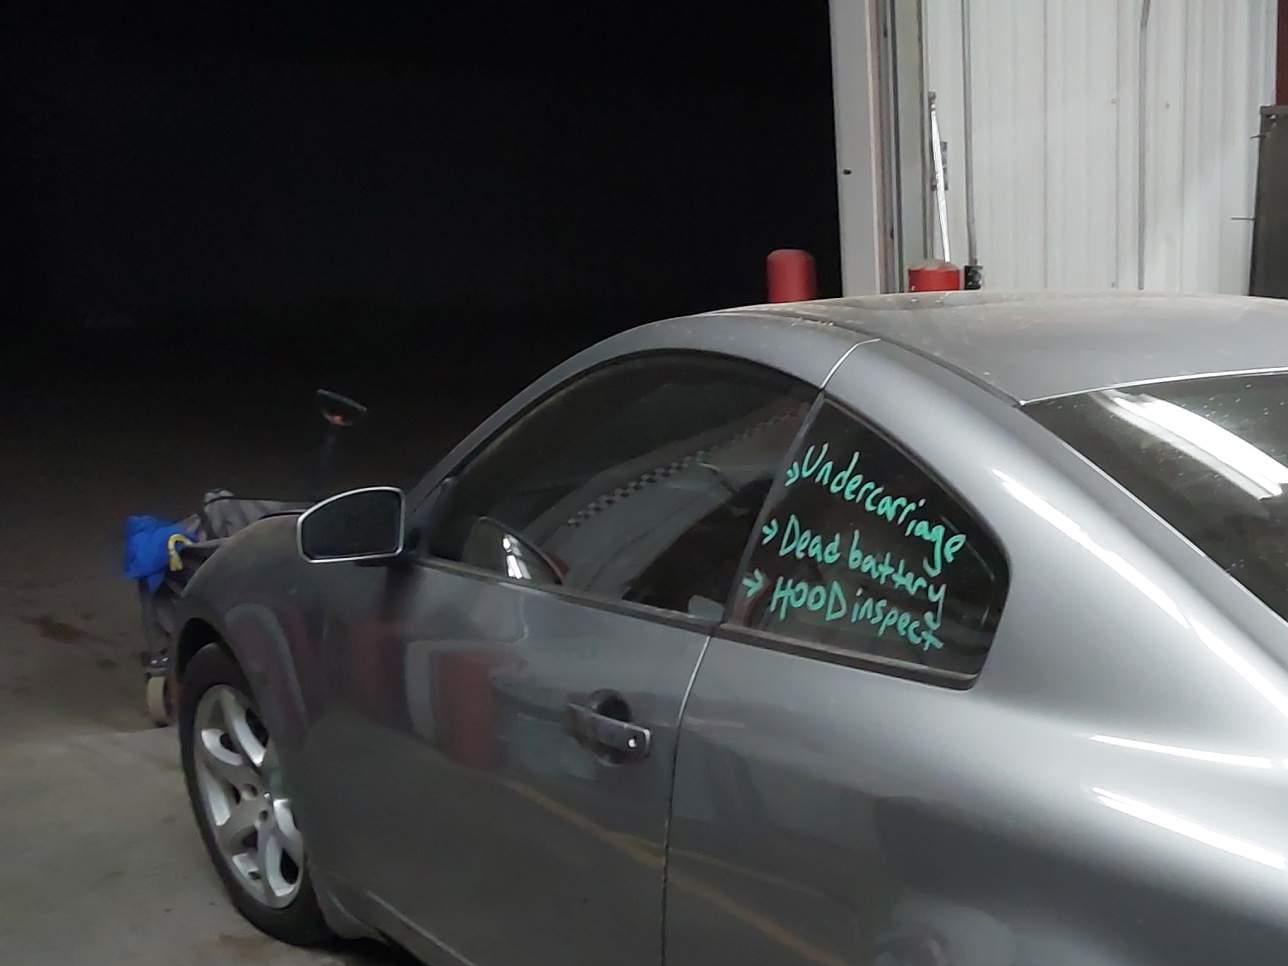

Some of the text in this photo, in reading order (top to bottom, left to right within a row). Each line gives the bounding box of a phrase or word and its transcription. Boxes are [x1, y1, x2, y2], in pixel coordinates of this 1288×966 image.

[801, 443, 967, 577] Undercarriage
[779, 514, 947, 630] Dead battery
[852, 588, 944, 650] inspect
